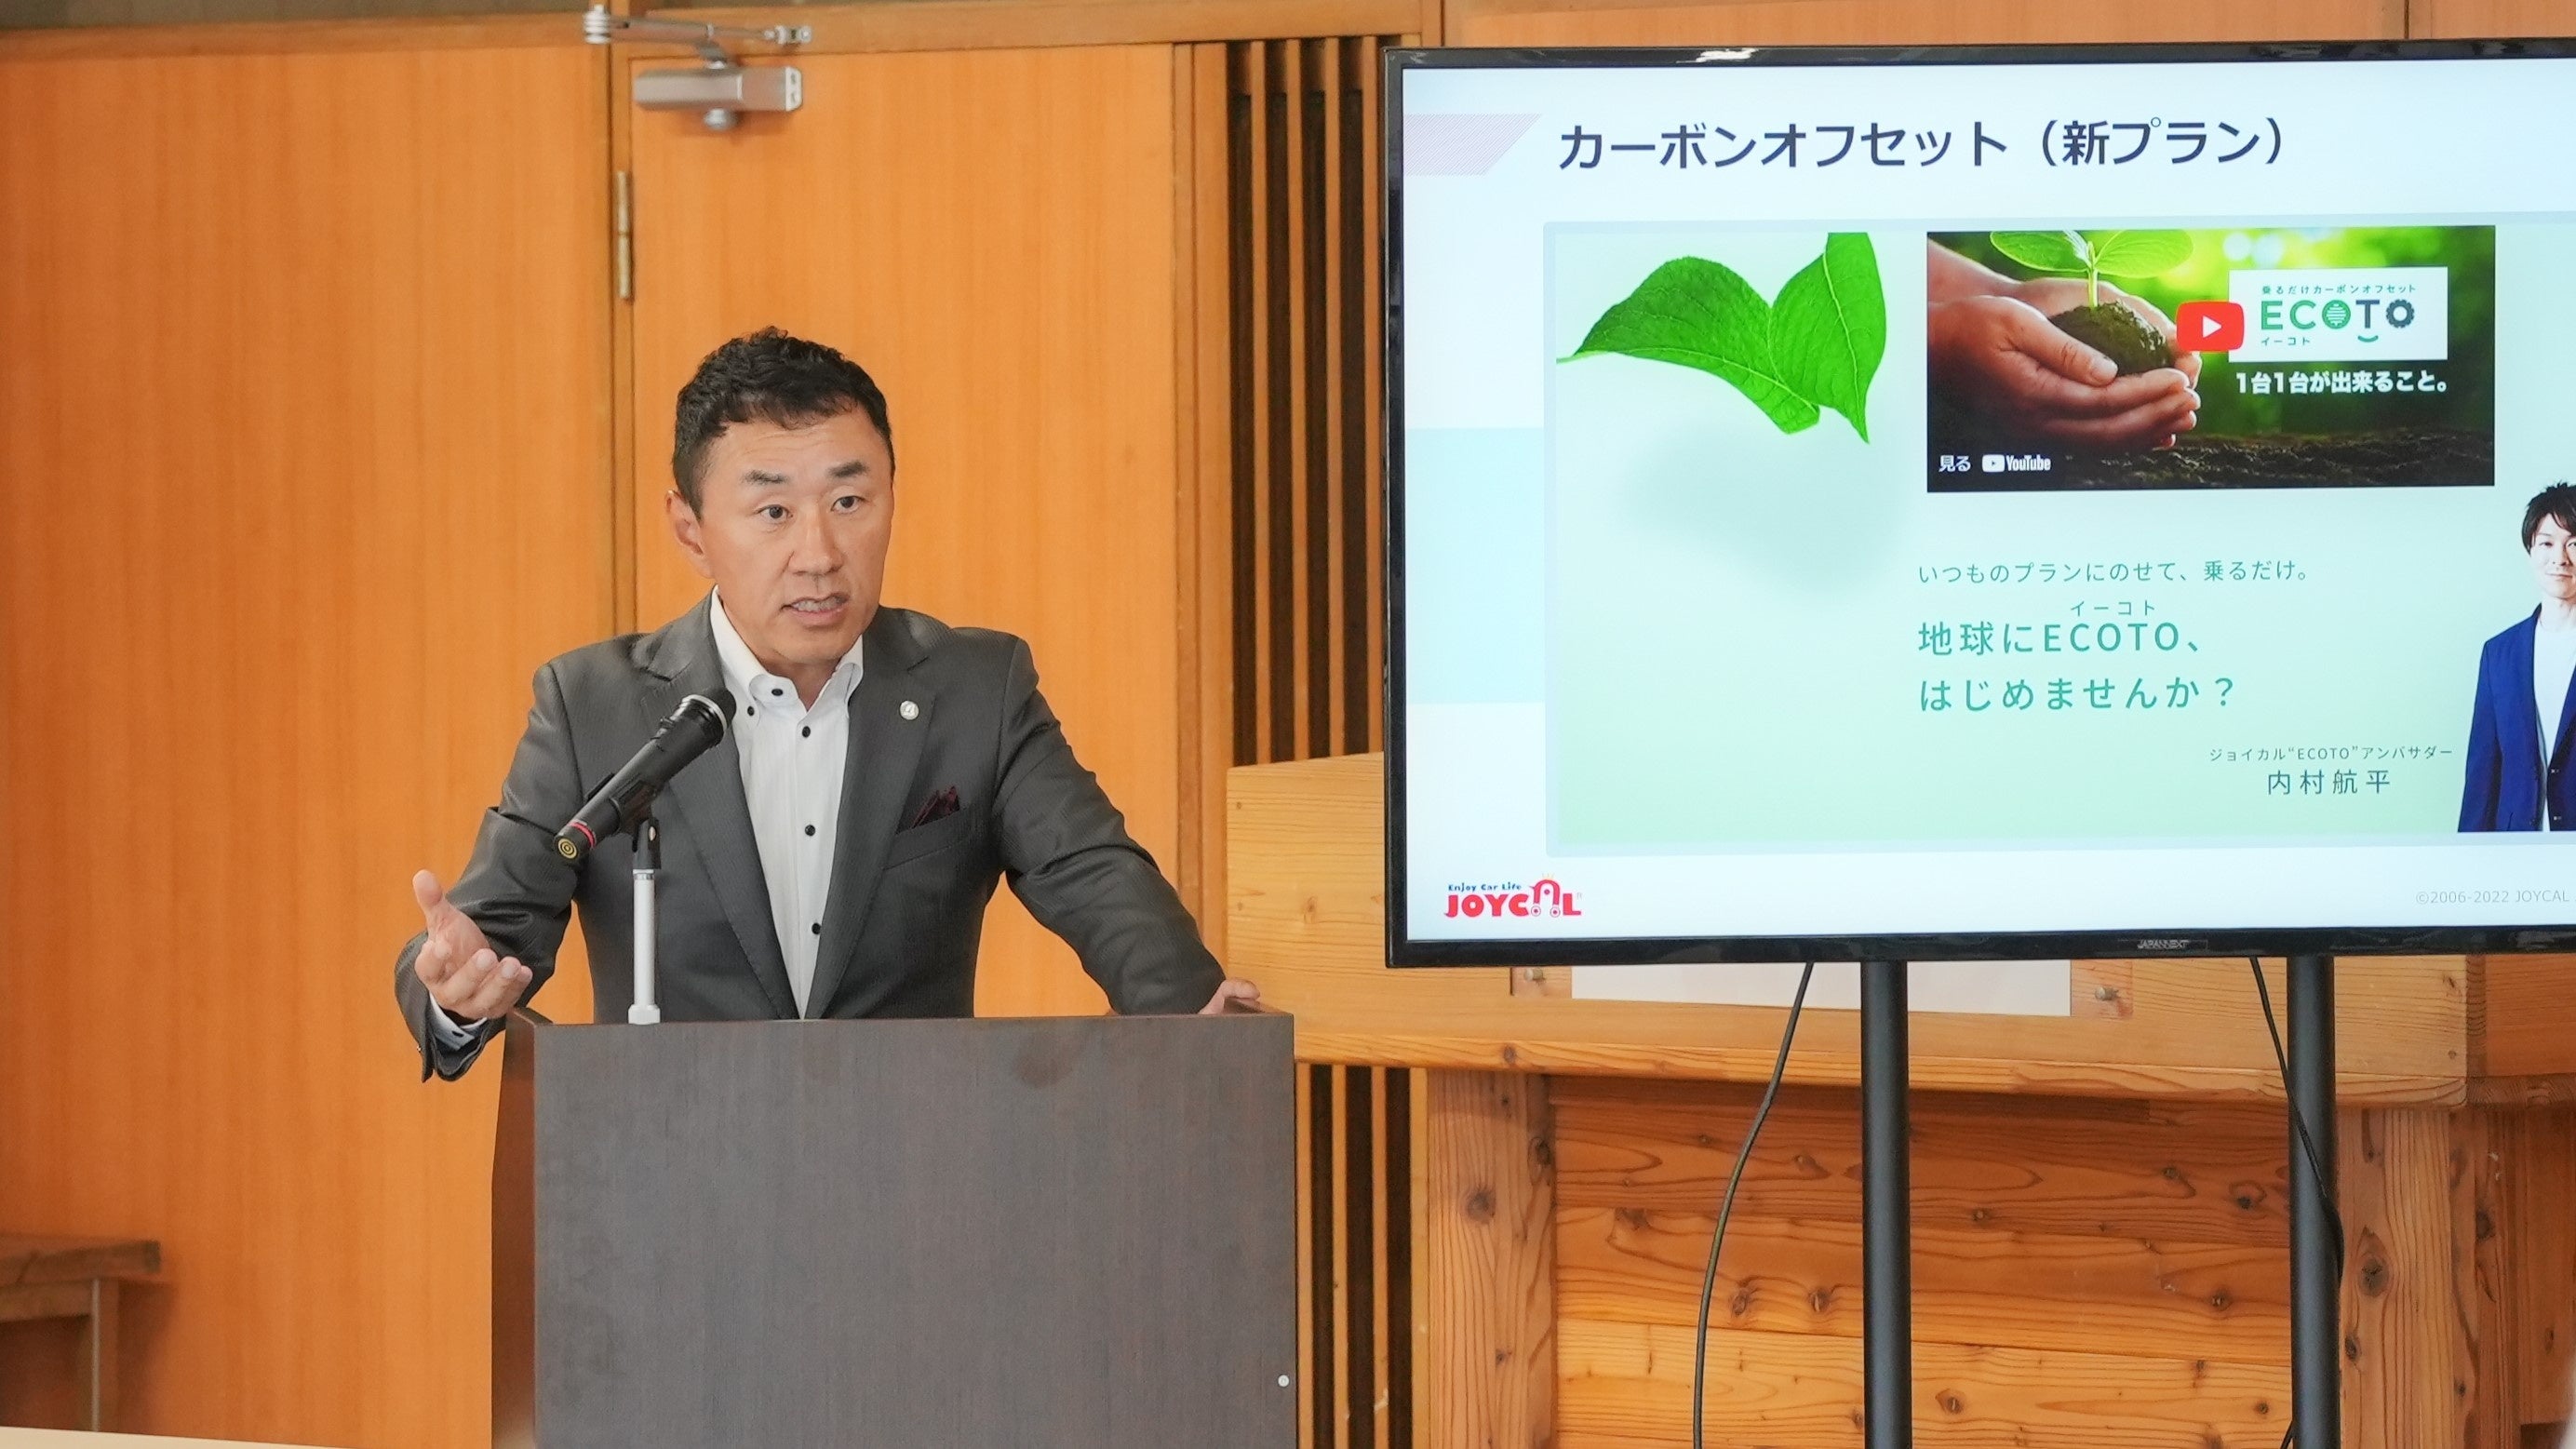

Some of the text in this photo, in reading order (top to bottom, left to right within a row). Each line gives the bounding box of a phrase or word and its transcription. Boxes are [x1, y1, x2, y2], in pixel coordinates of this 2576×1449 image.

[1560, 117, 2283, 170] カーボンオフセット（新プラン）
[2262, 284, 2416, 295] 乗るだけカーボンオフセット
[2261, 299, 2415, 329] ECOTO
[2261, 336, 2311, 346] イーコト
[2235, 370, 2447, 395] 1台1台が出来ること。
[1939, 454, 1971, 473] 見る
[2006, 454, 2051, 471] YouTube
[1918, 559, 2307, 584] いつものプランにのせて、乗るだけ。
[2070, 599, 2156, 616] イーコト
[1918, 621, 2199, 656] 地球にECOTO、
[2268, 770, 2391, 795] 内村航平
[1448, 882, 1477, 892] Enjoy
[1502, 881, 1523, 891] Life
[2516, 889, 2569, 903] JOYCAL
